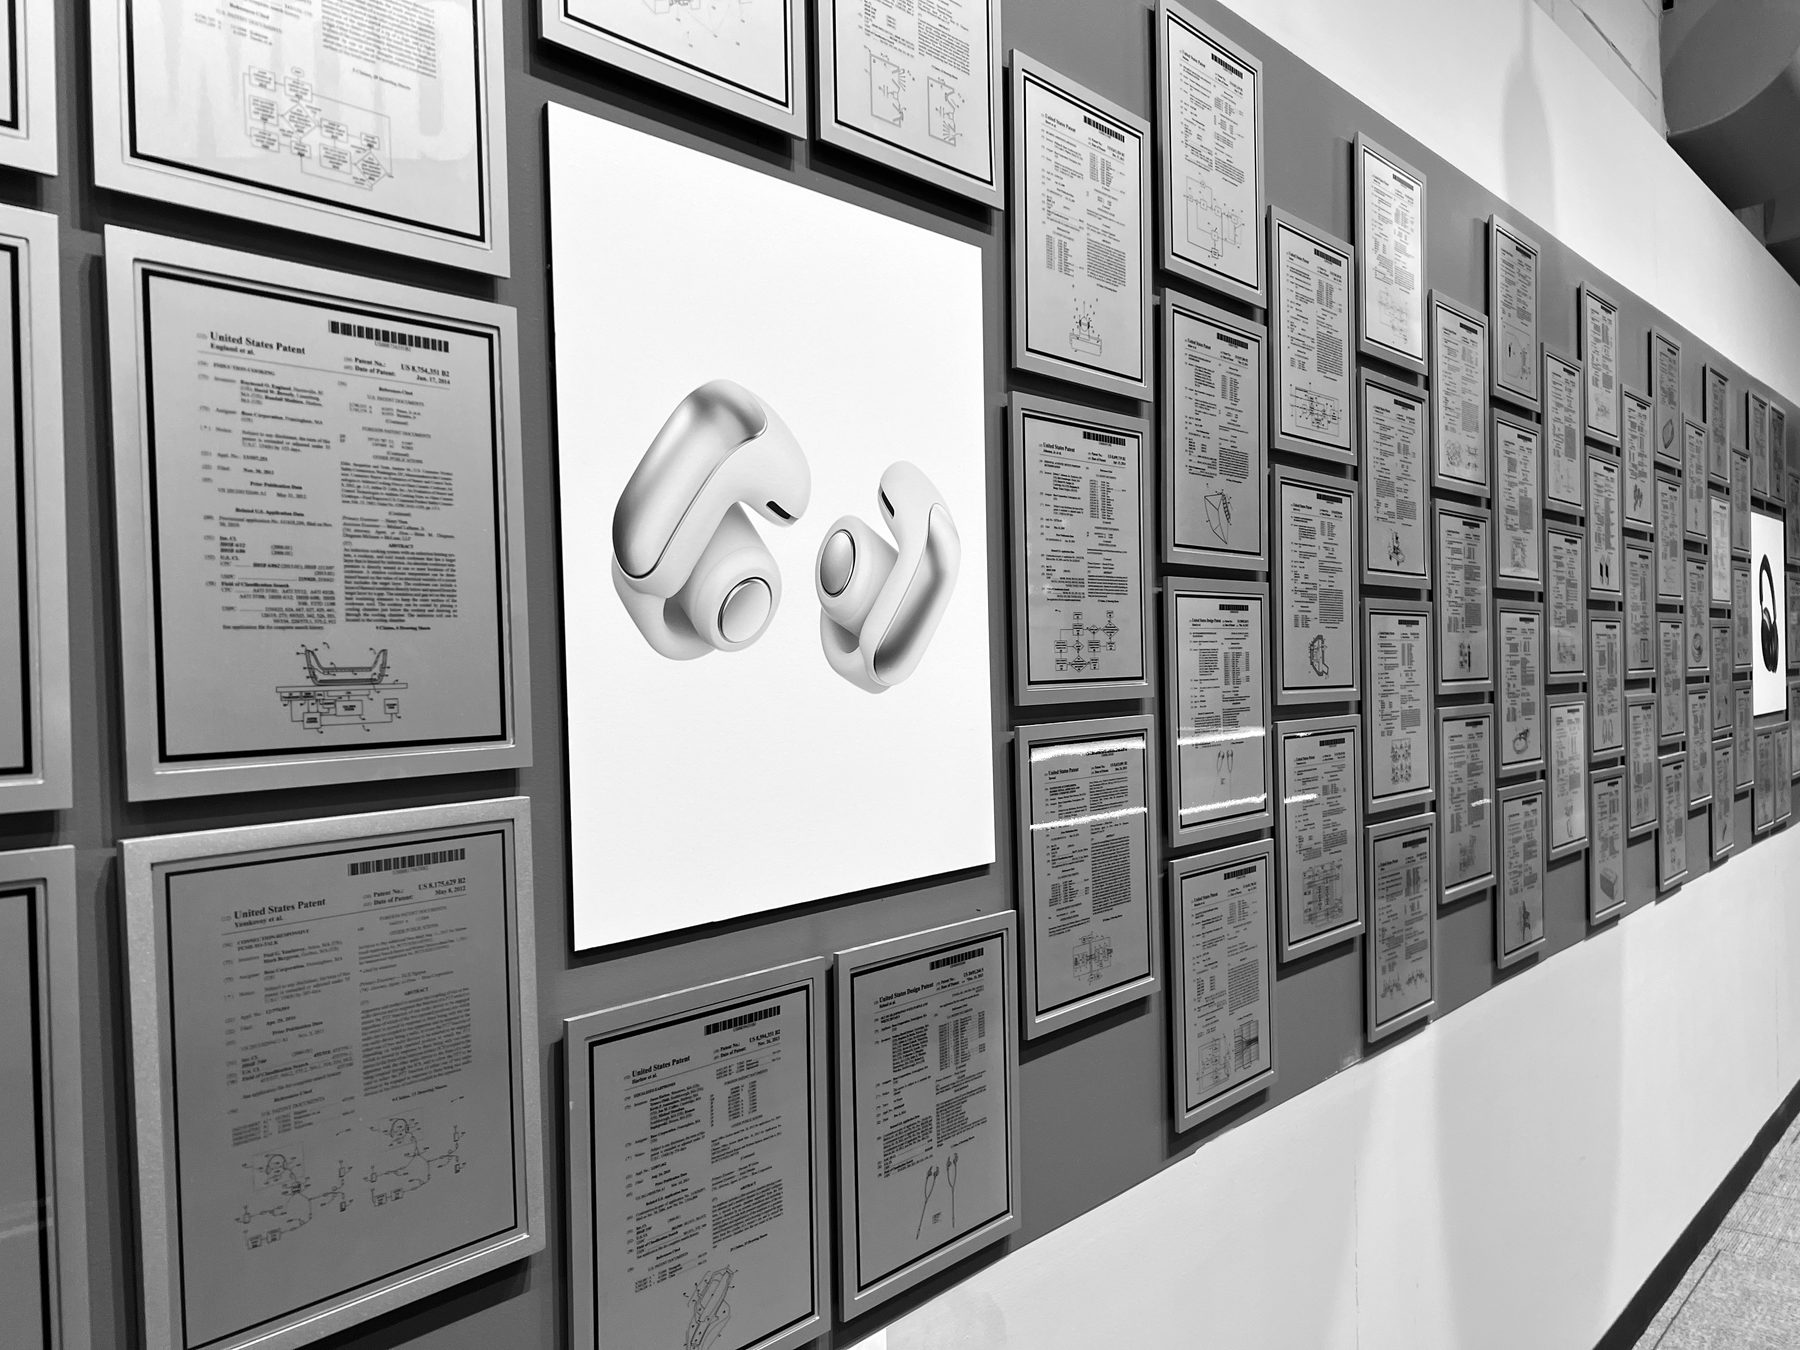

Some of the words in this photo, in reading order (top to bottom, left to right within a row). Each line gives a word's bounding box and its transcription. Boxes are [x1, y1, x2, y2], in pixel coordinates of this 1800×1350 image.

[210, 331, 242, 345] United
[246, 337, 274, 350] States
[276, 342, 306, 355] Patent
[354, 357, 372, 366] Patent
[400, 363, 410, 371] US
[440, 370, 450, 378] B2
[354, 365, 368, 373] Date
[373, 898, 386, 906] Date
[434, 888, 447, 897] May
[454, 885, 466, 893] 2012
[374, 889, 391, 898] Patent
[418, 883, 428, 891] US
[428, 878, 457, 890] 8,175,629
[457, 876, 466, 885] B2
[234, 906, 266, 920] United
[268, 901, 296, 915] States
[298, 897, 326, 910] Patent
[879, 993, 894, 1004] United
[894, 989, 906, 999] States
[906, 985, 920, 997] Design
[920, 981, 934, 991] Patent
[720, 1044, 732, 1053] Patent
[720, 1050, 730, 1058] Date
[632, 1065, 652, 1078] United
[652, 1060, 671, 1072] States
[672, 1054, 690, 1066] Patent
